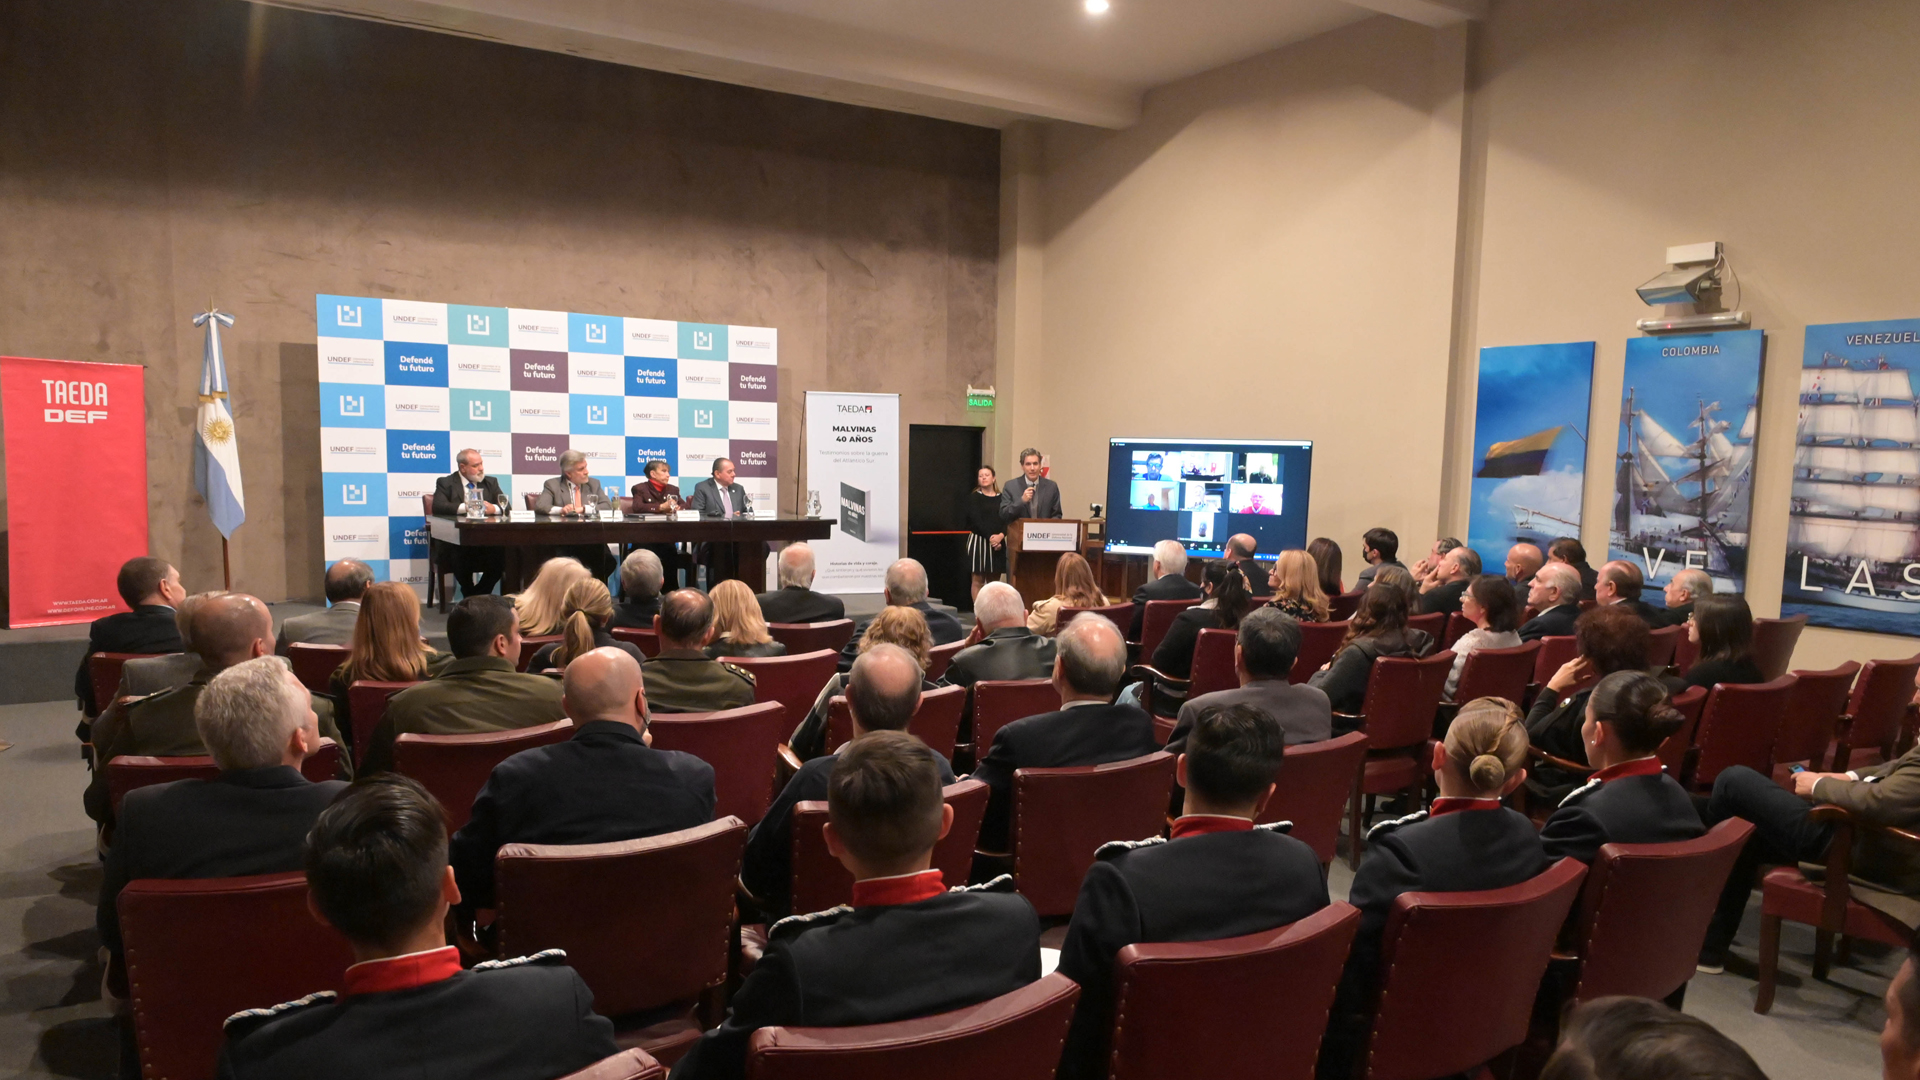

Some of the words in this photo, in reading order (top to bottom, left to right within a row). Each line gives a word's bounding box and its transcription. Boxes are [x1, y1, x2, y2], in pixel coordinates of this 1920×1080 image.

[1846, 332, 1920, 346] VENEZUEL
[1662, 345, 1720, 357] COLOMBIA
[400, 355, 433, 365] Defendé
[399, 364, 408, 372] tu
[409, 364, 435, 373] futuro
[524, 362, 555, 371] Defendé
[533, 371, 556, 379] futuro
[637, 369, 665, 378] Defendé
[645, 377, 666, 385] futuro
[740, 375, 766, 383] Defendé
[41, 379, 108, 406] TAEDA
[969, 399, 993, 407] SALIDA
[837, 405, 865, 413] TAEDA
[44, 408, 108, 424] DEF
[849, 435, 873, 443] AÑOS
[402, 443, 435, 451] Defendé
[526, 446, 556, 454] Defendé
[401, 451, 410, 459] tu
[412, 451, 436, 459] futuro
[638, 449, 665, 457] Defendé
[741, 451, 766, 459] Defendé
[748, 458, 767, 466] futuro
[841, 496, 865, 515] MALVINAS
[405, 529, 427, 537] Defen
